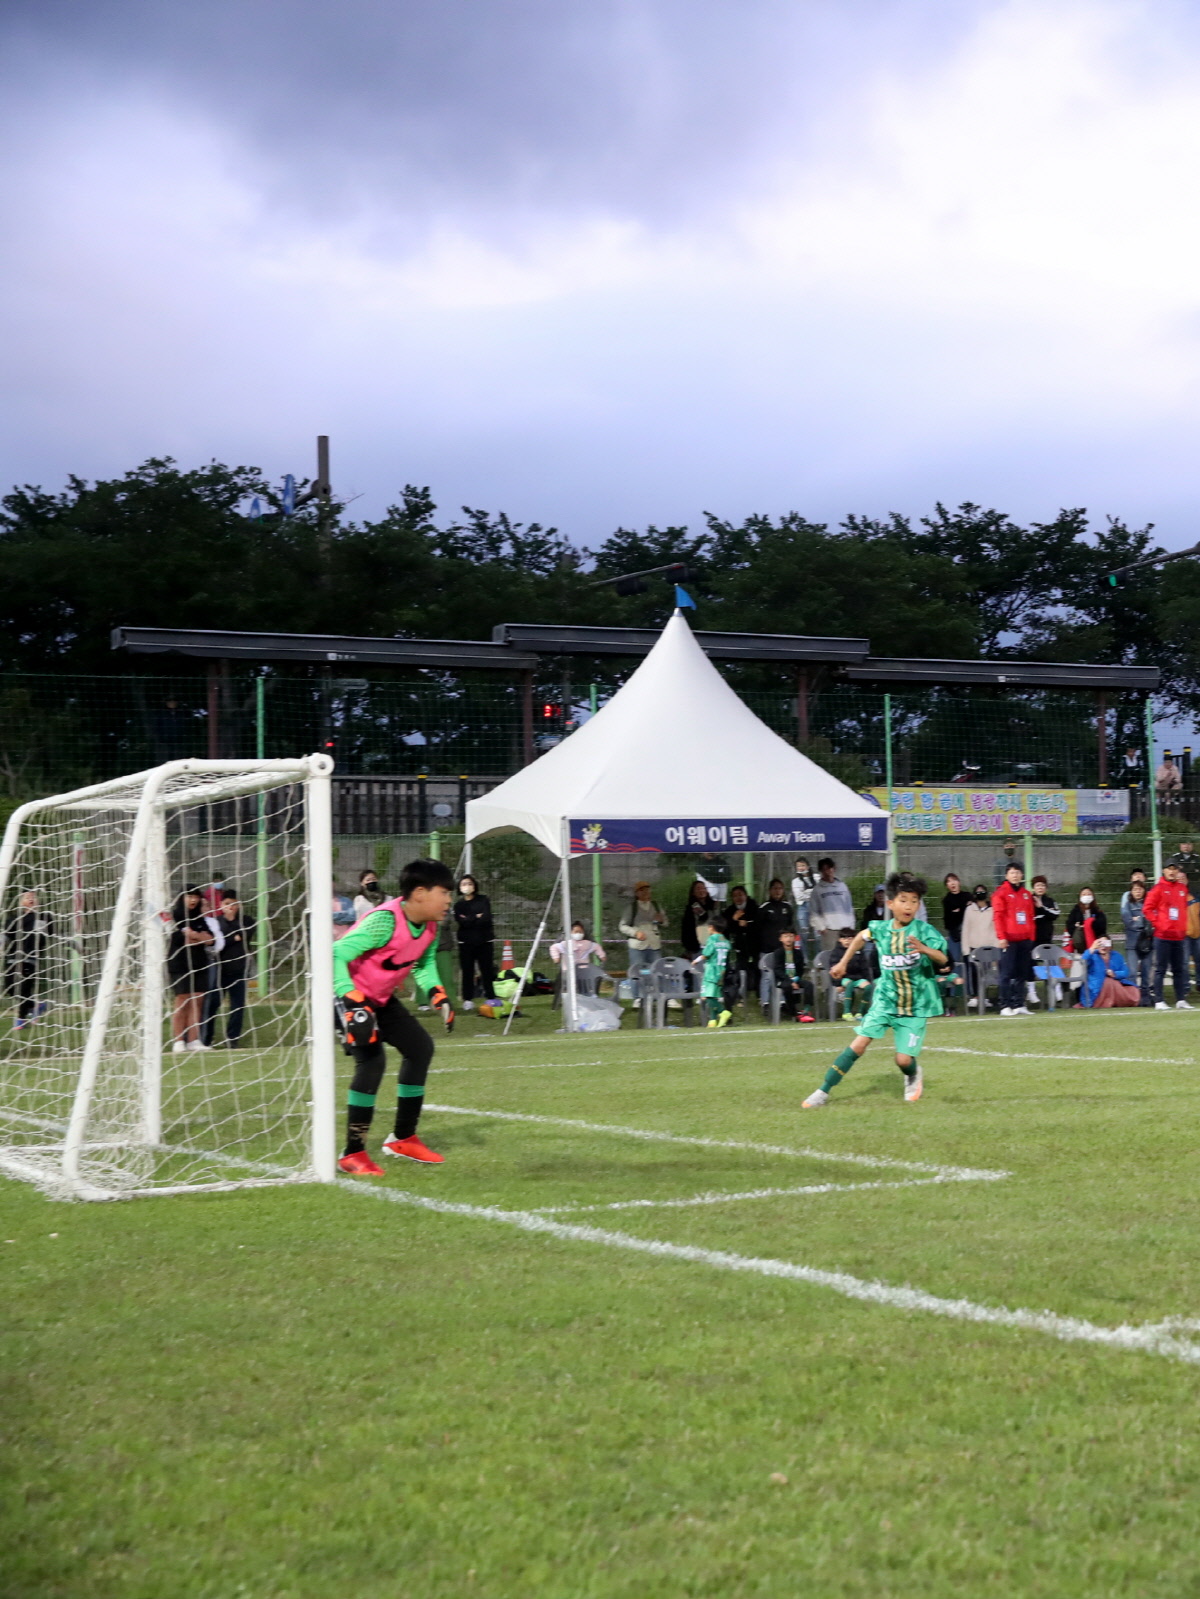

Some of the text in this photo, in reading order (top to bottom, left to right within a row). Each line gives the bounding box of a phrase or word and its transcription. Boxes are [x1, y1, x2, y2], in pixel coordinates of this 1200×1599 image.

[970, 793, 1022, 811] 열광하지
[896, 813, 947, 832] 너희들의
[952, 813, 1003, 832] 즐거움에
[665, 825, 826, 845] 어웨이팀 Away Team
